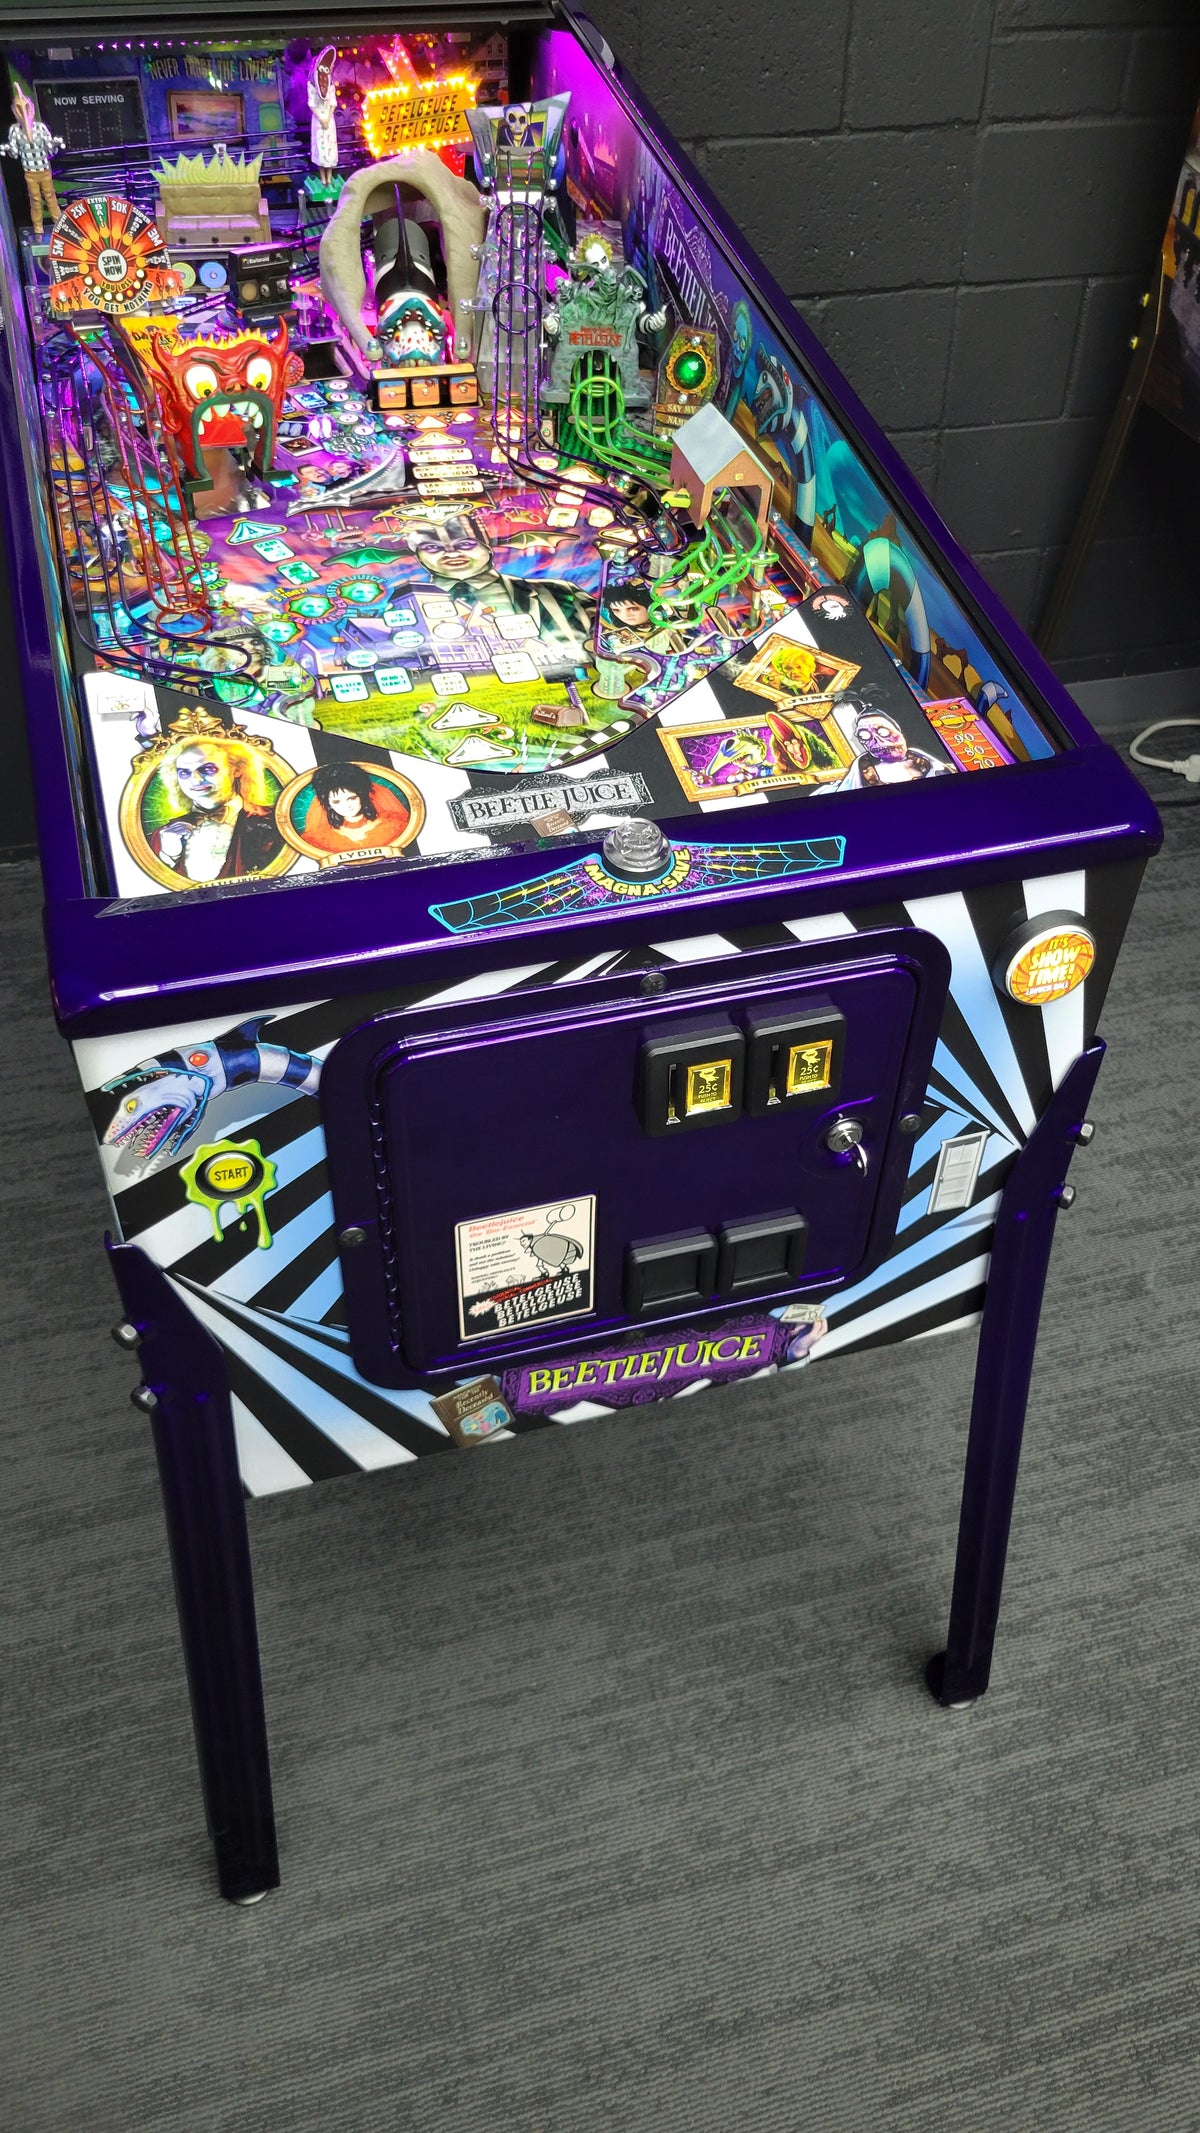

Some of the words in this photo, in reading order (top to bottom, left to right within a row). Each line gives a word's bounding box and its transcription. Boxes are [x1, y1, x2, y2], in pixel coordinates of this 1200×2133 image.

[150, 57, 180, 80] NEVER
[54, 96, 77, 106] NOW
[82, 94, 125, 105] SERVING
[379, 95, 458, 123] BETELGEUSE
[384, 114, 461, 143] BETELGEUSE
[70, 204, 87, 219] 25K
[110, 200, 128, 214] 50K
[102, 255, 121, 266] SPIN
[103, 265, 123, 276] NOW
[82, 287, 100, 306] YOU
[104, 302, 119, 313] GET
[124, 281, 153, 312] NOTHING
[667, 404, 682, 413] SAY
[684, 405, 697, 414] MY
[953, 732, 975, 744] 90
[964, 745, 985, 756] 80
[973, 758, 995, 770] 70
[467, 792, 558, 820] BEETLE
[562, 783, 633, 810] JUICE
[338, 847, 384, 862] LYDIA
[582, 848, 692, 897] MAGNA-SAVE
[1048, 937, 1069, 951] IT'S
[1029, 945, 1082, 970] SHOW
[1027, 963, 1076, 988] TIME!
[800, 1064, 819, 1076] 25¢
[698, 1082, 718, 1094] 25¢
[214, 1166, 249, 1181] START
[468, 1216, 525, 1233] Beetlejuice
[494, 1273, 579, 1313] BETELGEUSE
[497, 1280, 581, 1320] BETELGEUSE
[498, 1288, 583, 1328] BETELGEUSE
[527, 1333, 766, 1397] BEETLEJUICE
